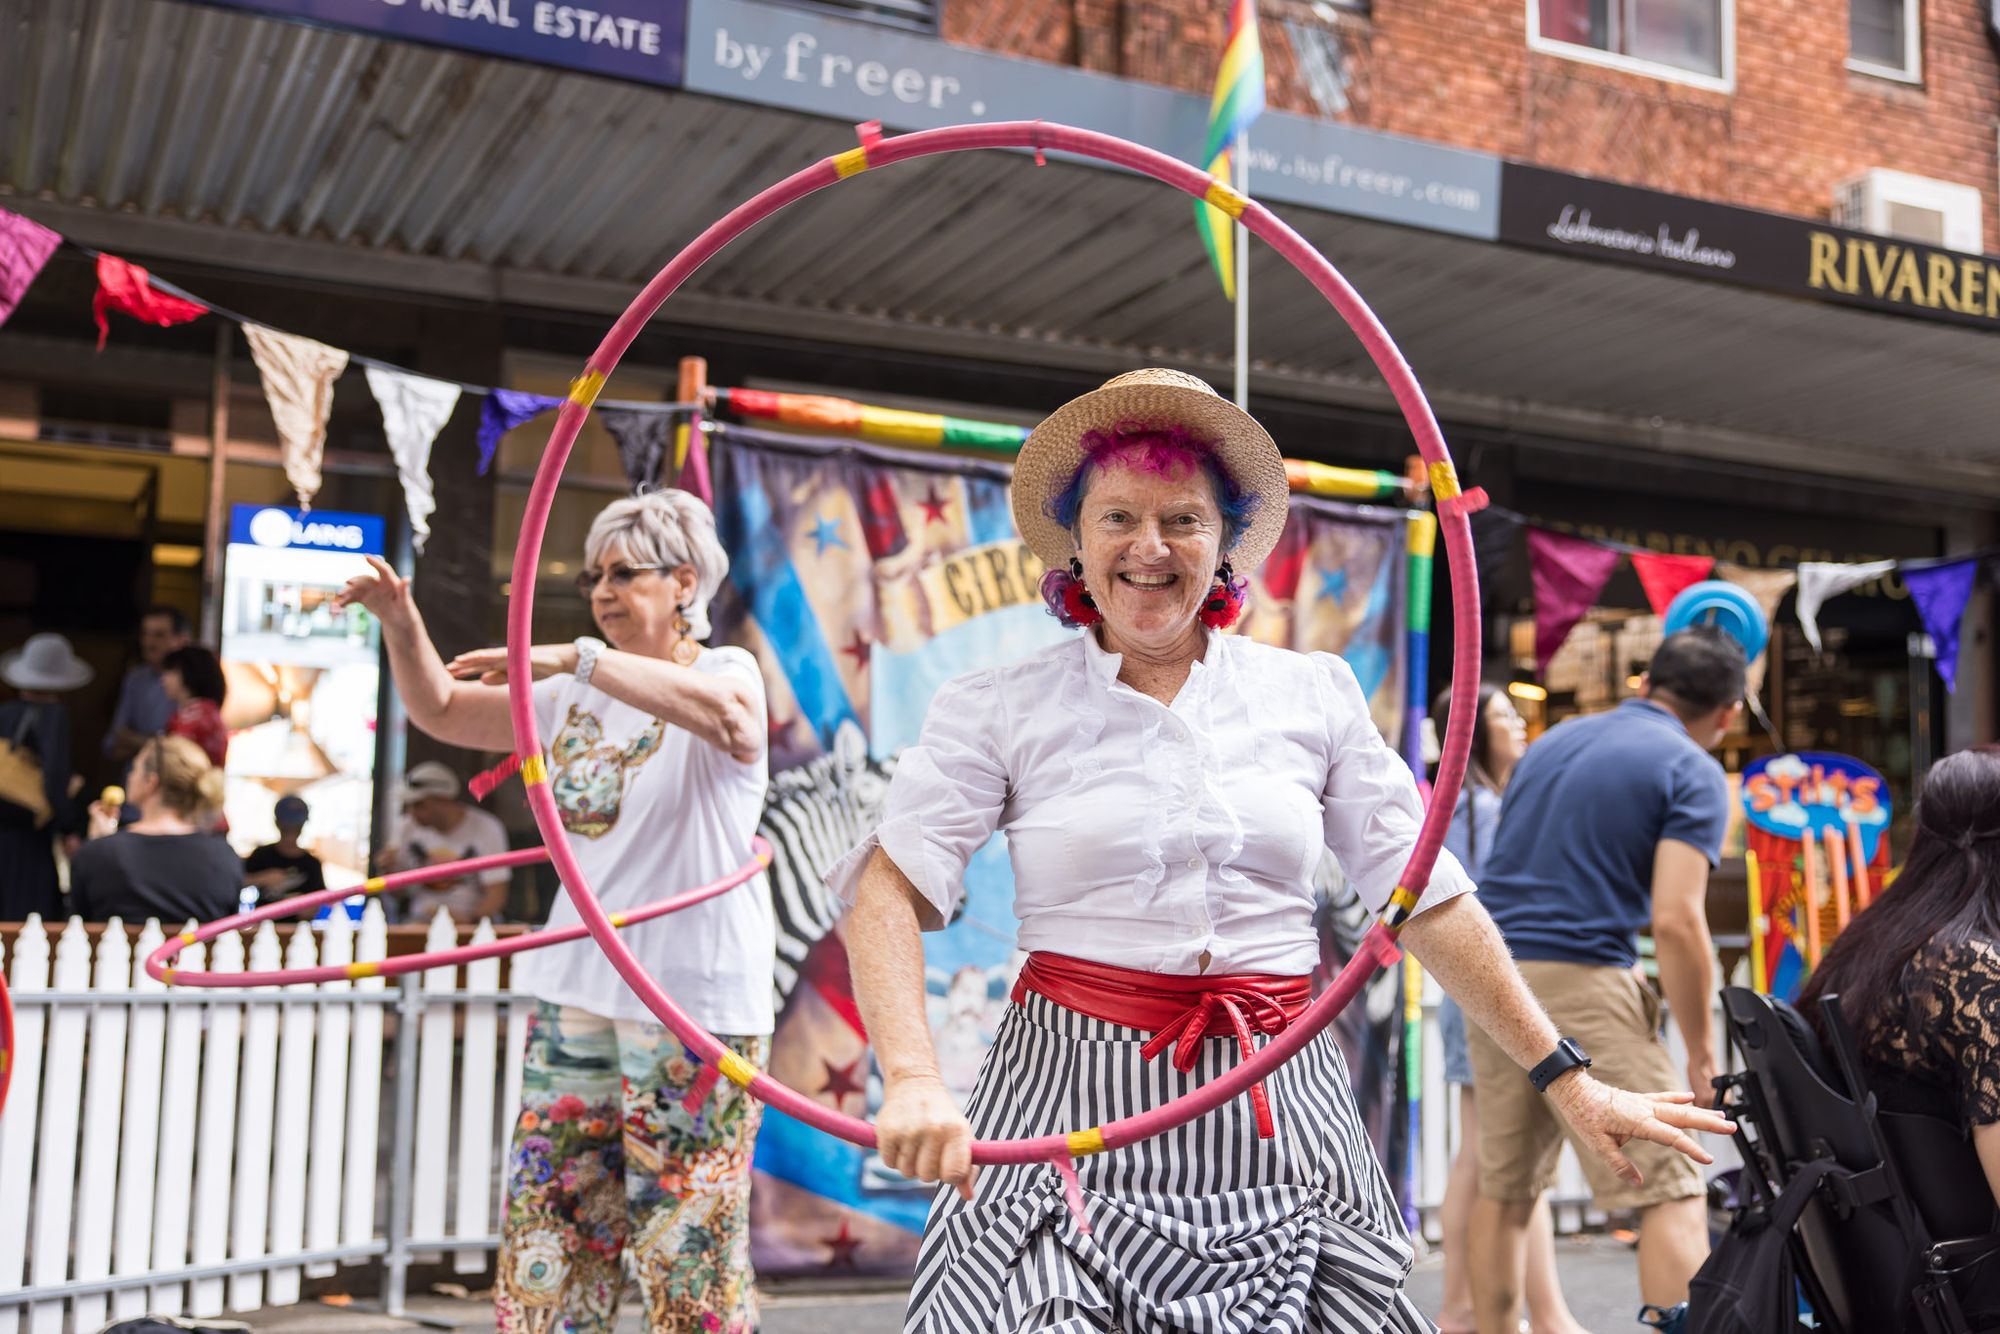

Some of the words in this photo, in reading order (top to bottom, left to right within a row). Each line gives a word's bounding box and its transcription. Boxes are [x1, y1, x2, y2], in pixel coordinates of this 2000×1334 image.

[534, 1, 661, 55] ESTATE
[715, 28, 770, 80] by
[1236, 148, 1480, 211] w.byfreer.com
[945, 544, 1037, 616] CIRC
